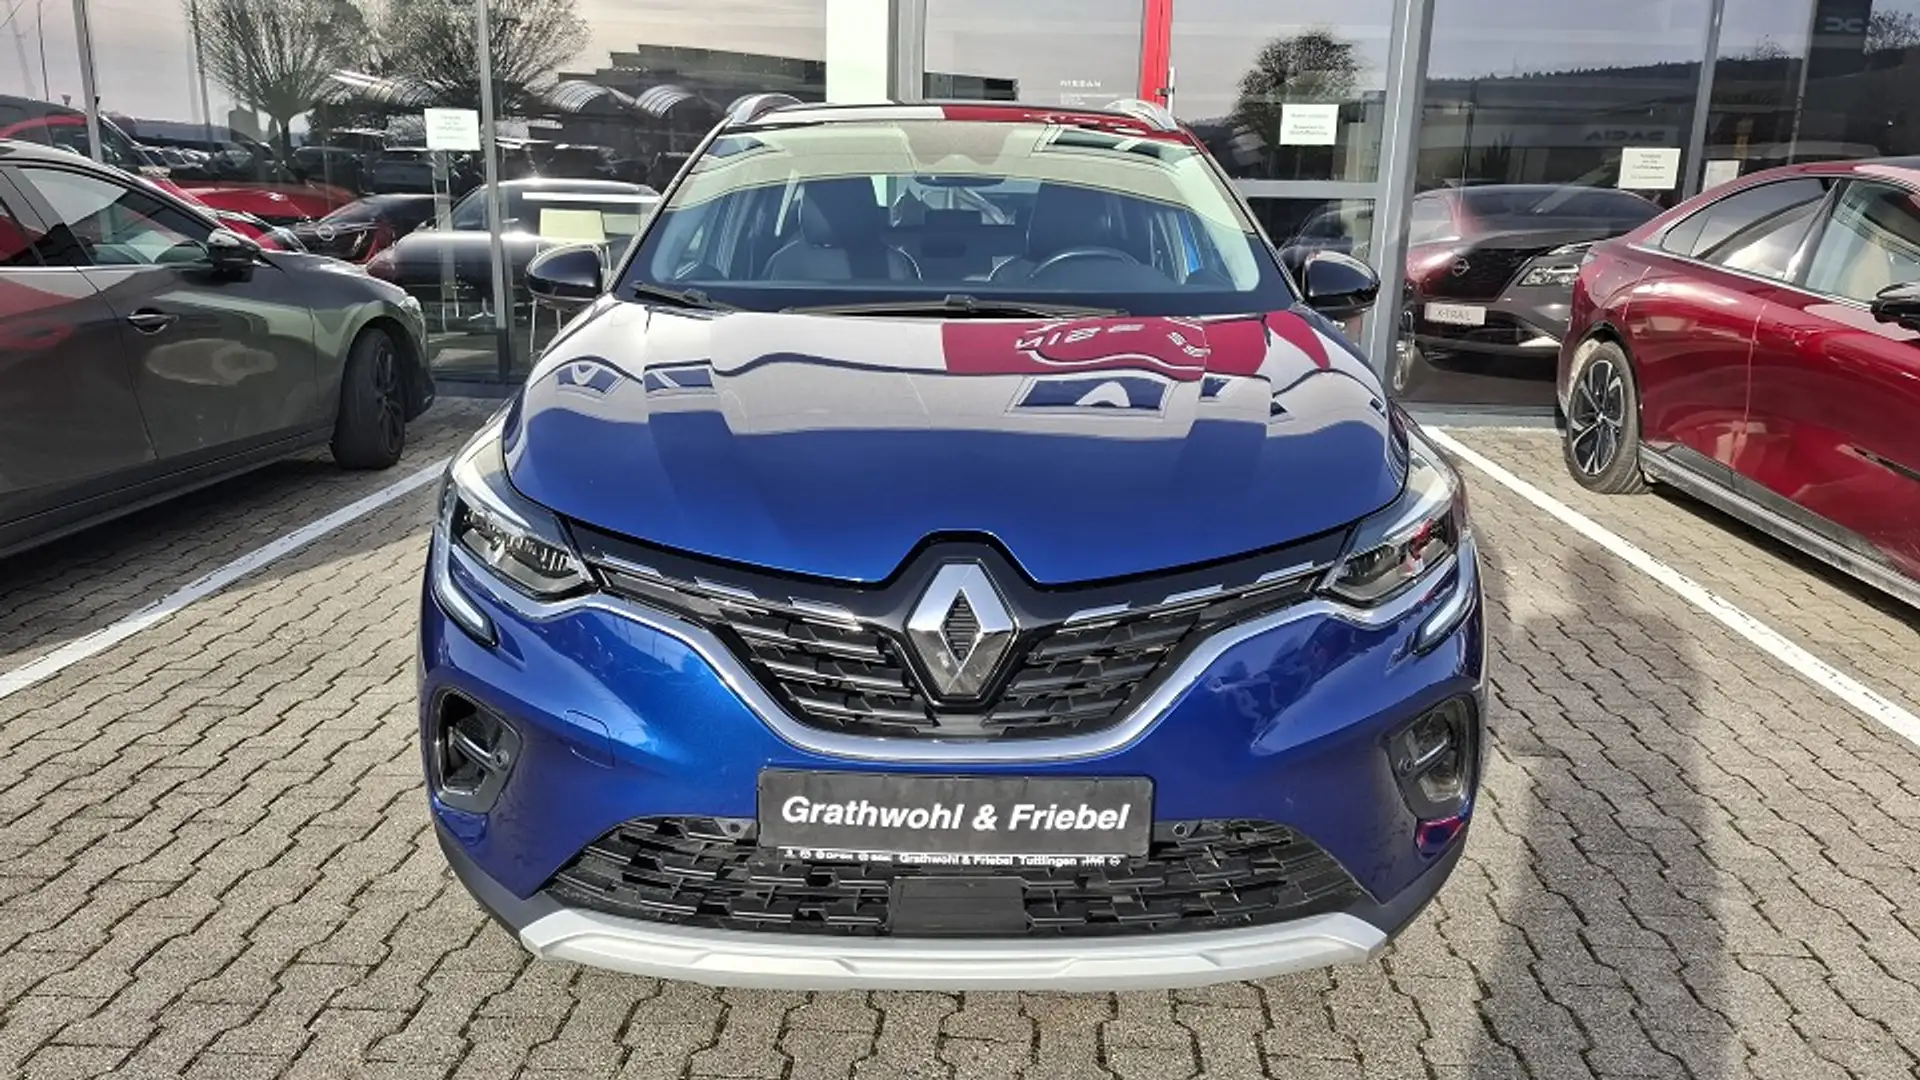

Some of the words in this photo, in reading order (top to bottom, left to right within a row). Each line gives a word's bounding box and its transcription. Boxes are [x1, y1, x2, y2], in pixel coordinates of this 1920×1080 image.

[781, 795, 965, 830] Grathwohl
[972, 803, 998, 831] &
[1008, 803, 1131, 831] Friebel
[899, 852, 959, 865] Grathwohl
[973, 855, 1013, 866] Friebel
[1019, 855, 1078, 868] Tuttlingen
